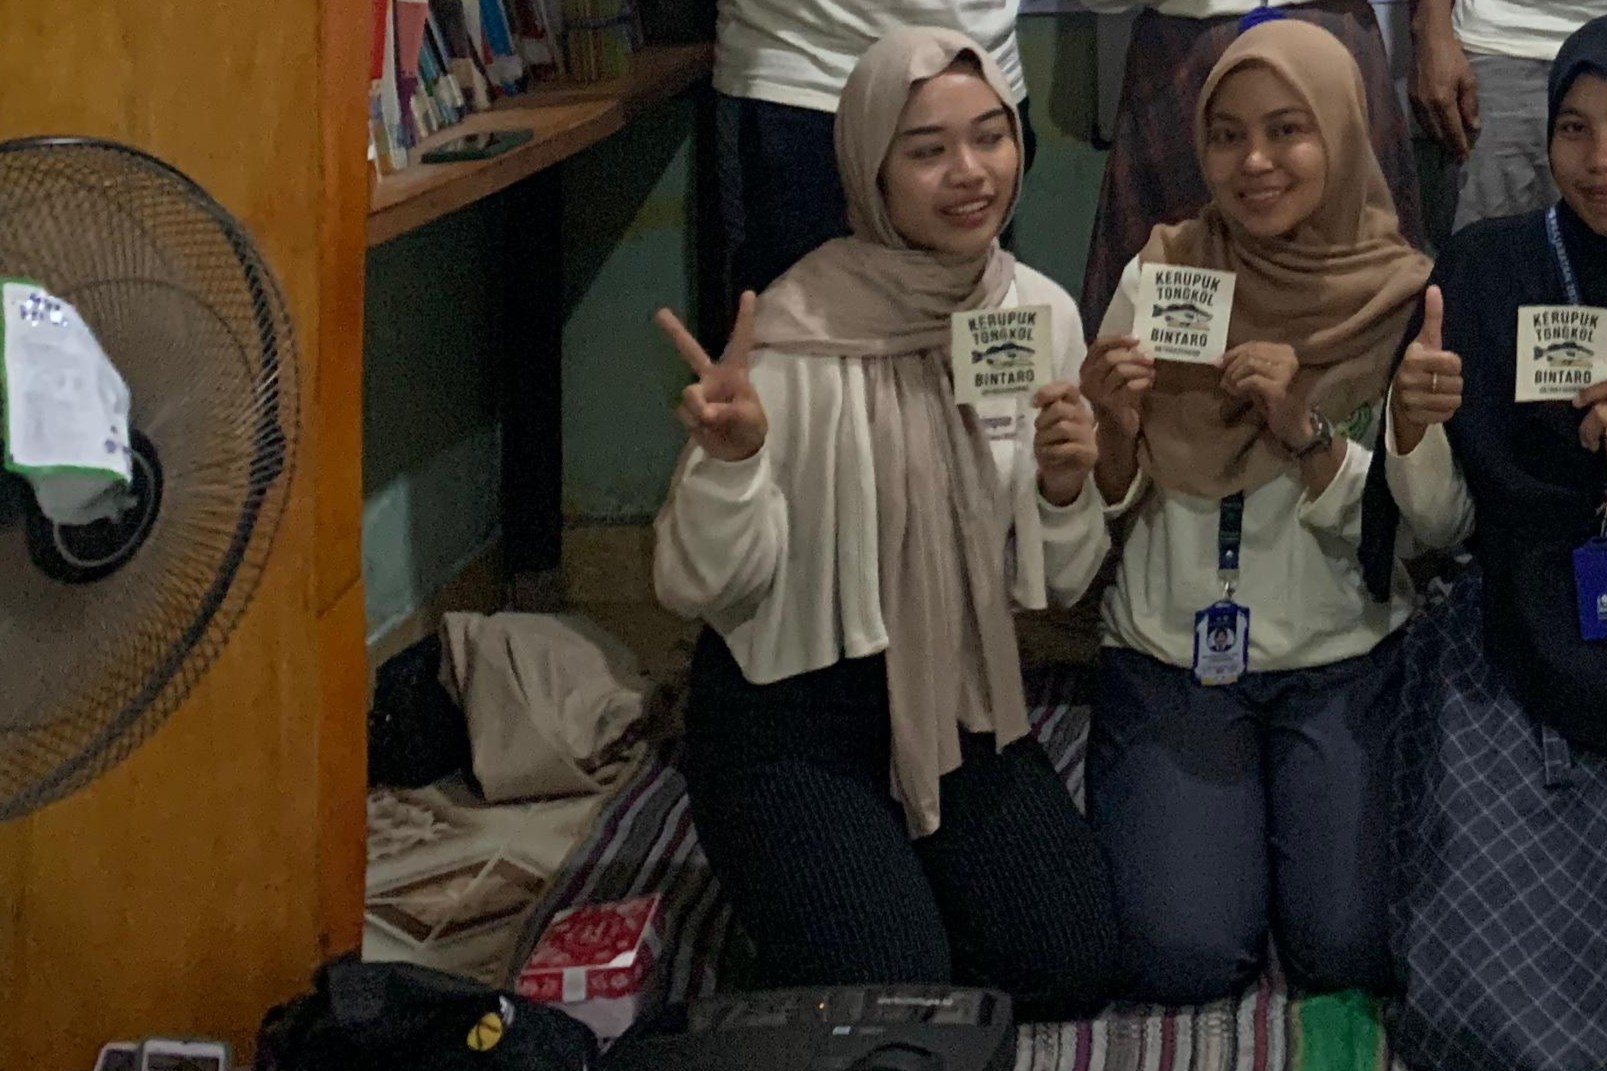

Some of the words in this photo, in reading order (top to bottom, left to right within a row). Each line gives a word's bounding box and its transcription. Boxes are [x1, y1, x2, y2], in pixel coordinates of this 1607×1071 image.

[1155, 271, 1221, 293] KERUPUK
[1158, 287, 1214, 307] TONGKOL
[968, 311, 1037, 332] KERUPUK
[1533, 310, 1600, 330] KERUPUK
[972, 327, 1034, 346] TONGKOL
[1150, 328, 1208, 347] BINTARO
[1535, 326, 1595, 342] TONGKOL
[974, 369, 1035, 387] BINTARO
[1534, 370, 1592, 384] BINTARO
